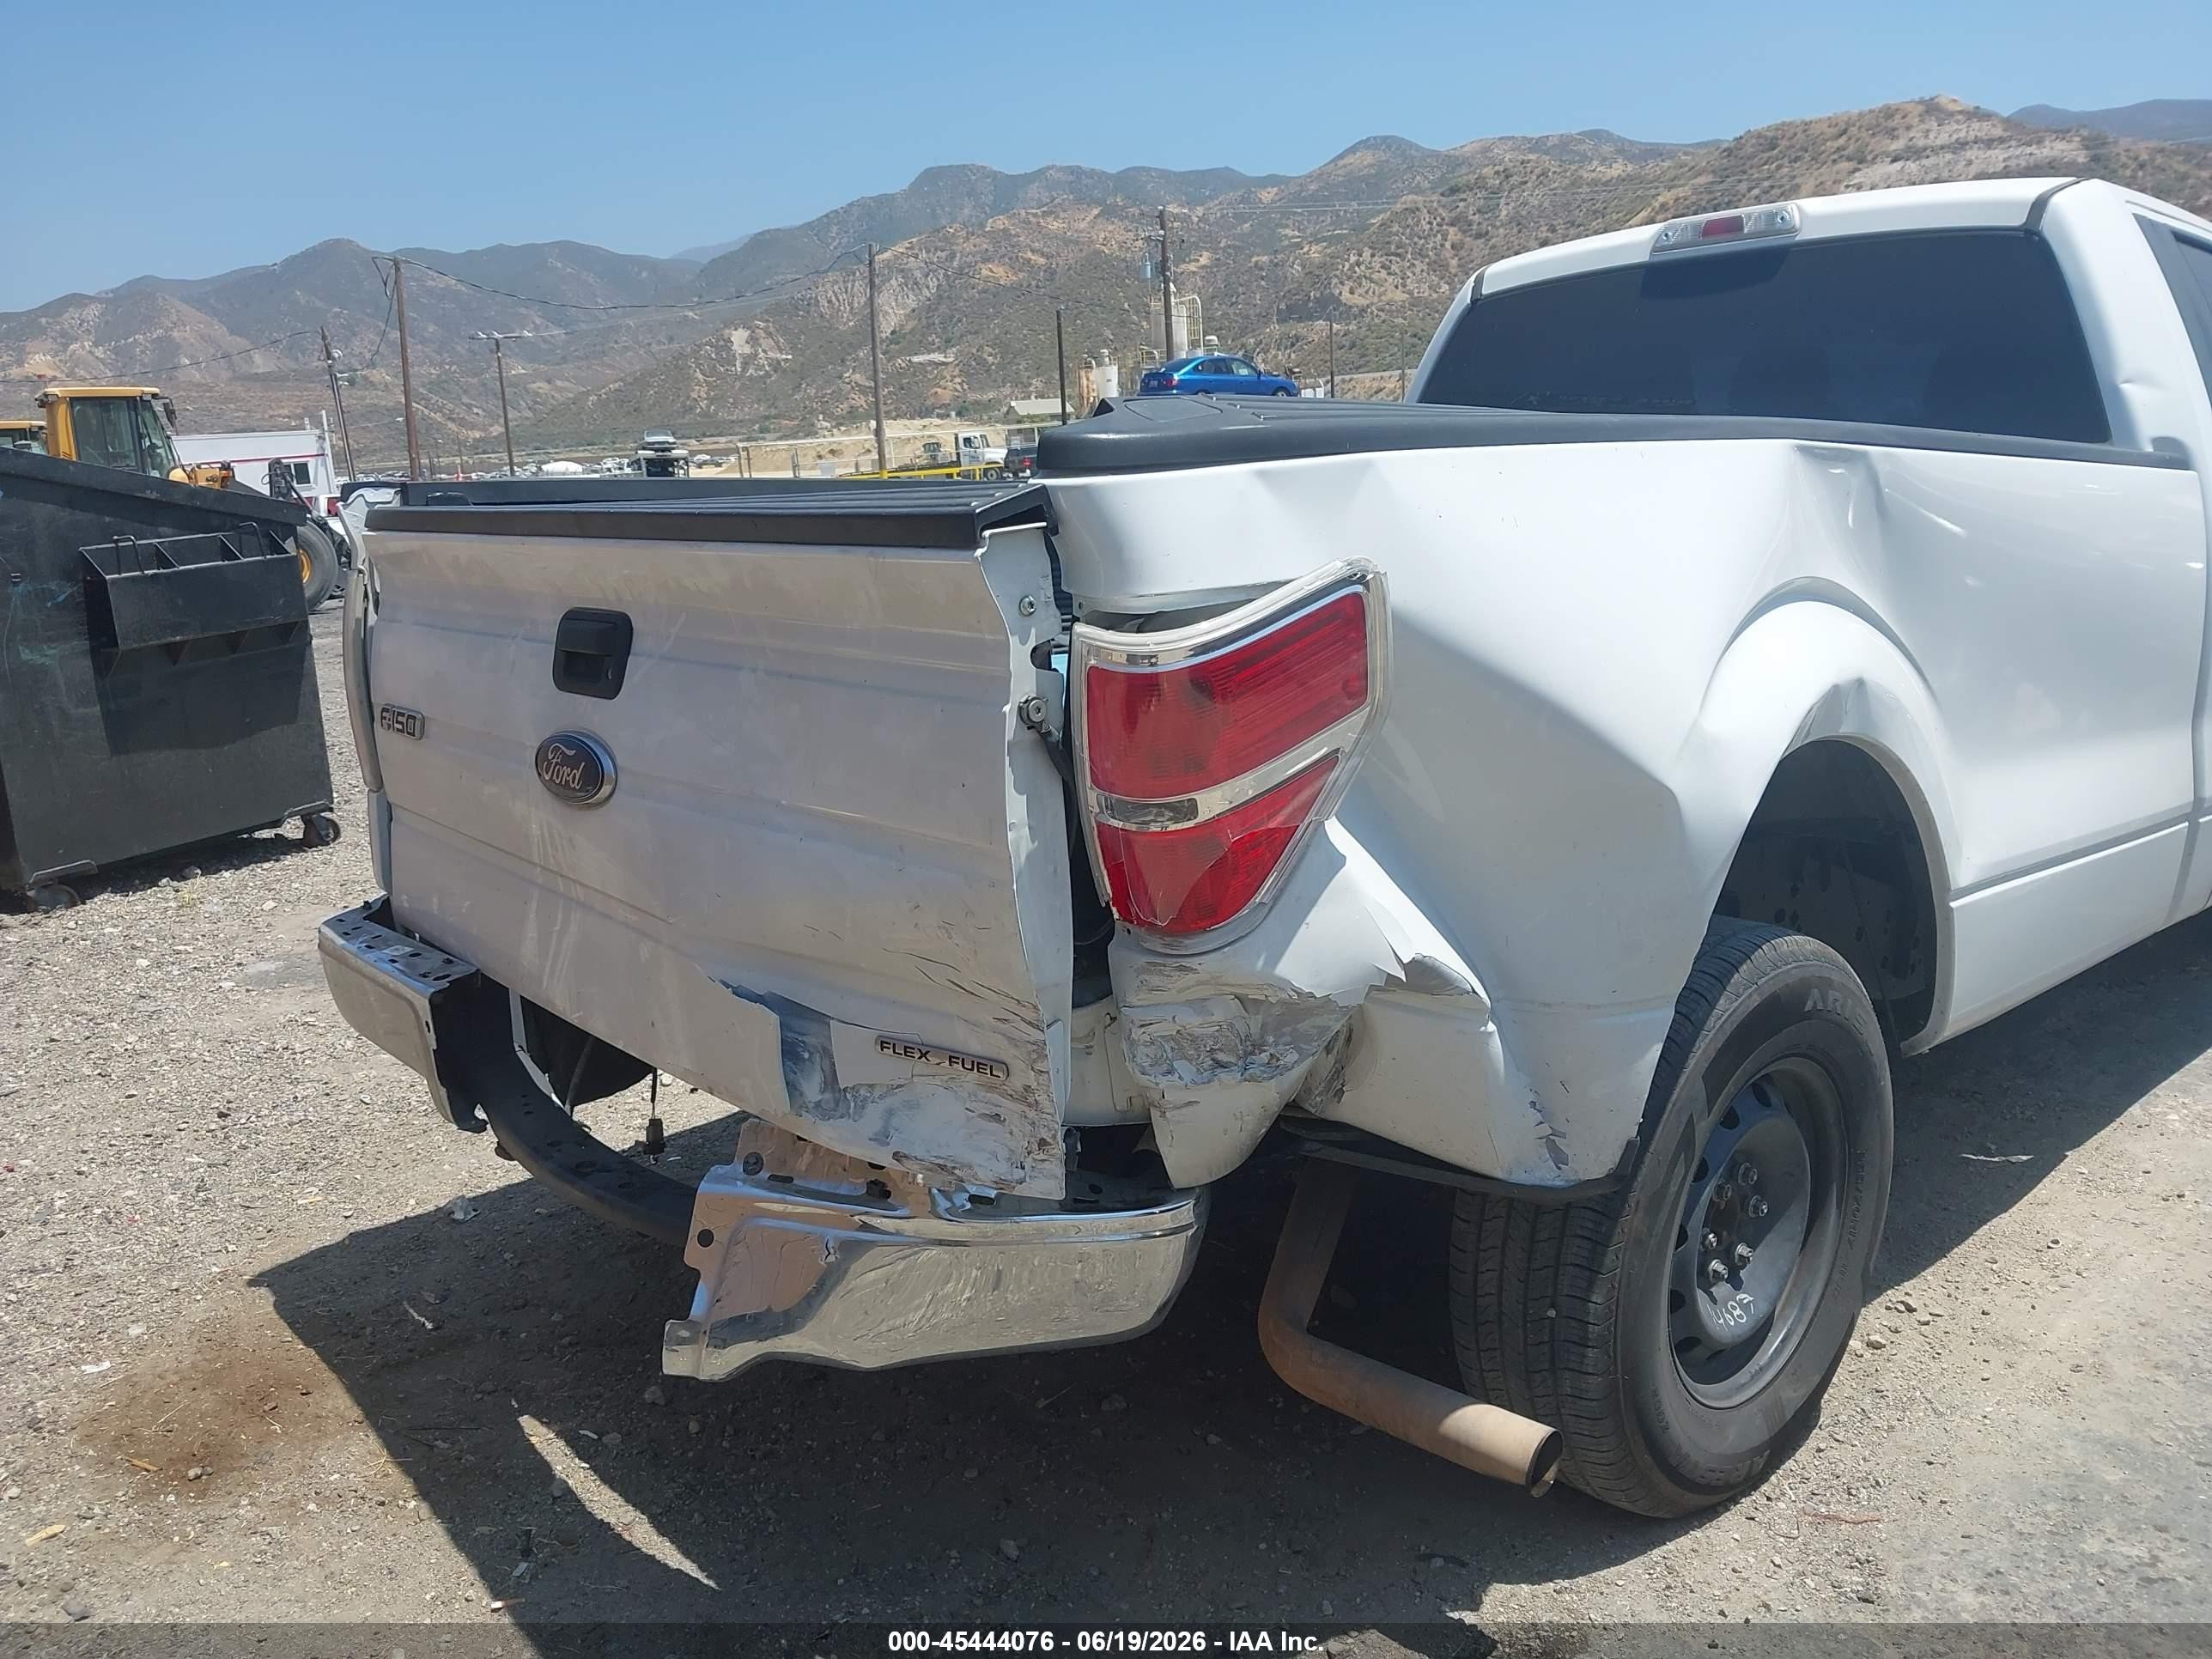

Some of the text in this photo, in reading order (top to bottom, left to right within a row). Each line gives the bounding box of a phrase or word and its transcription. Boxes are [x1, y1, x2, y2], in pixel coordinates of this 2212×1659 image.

[543, 743, 585, 789] Ford
[879, 1040, 1001, 1079] FLEX FUEL
